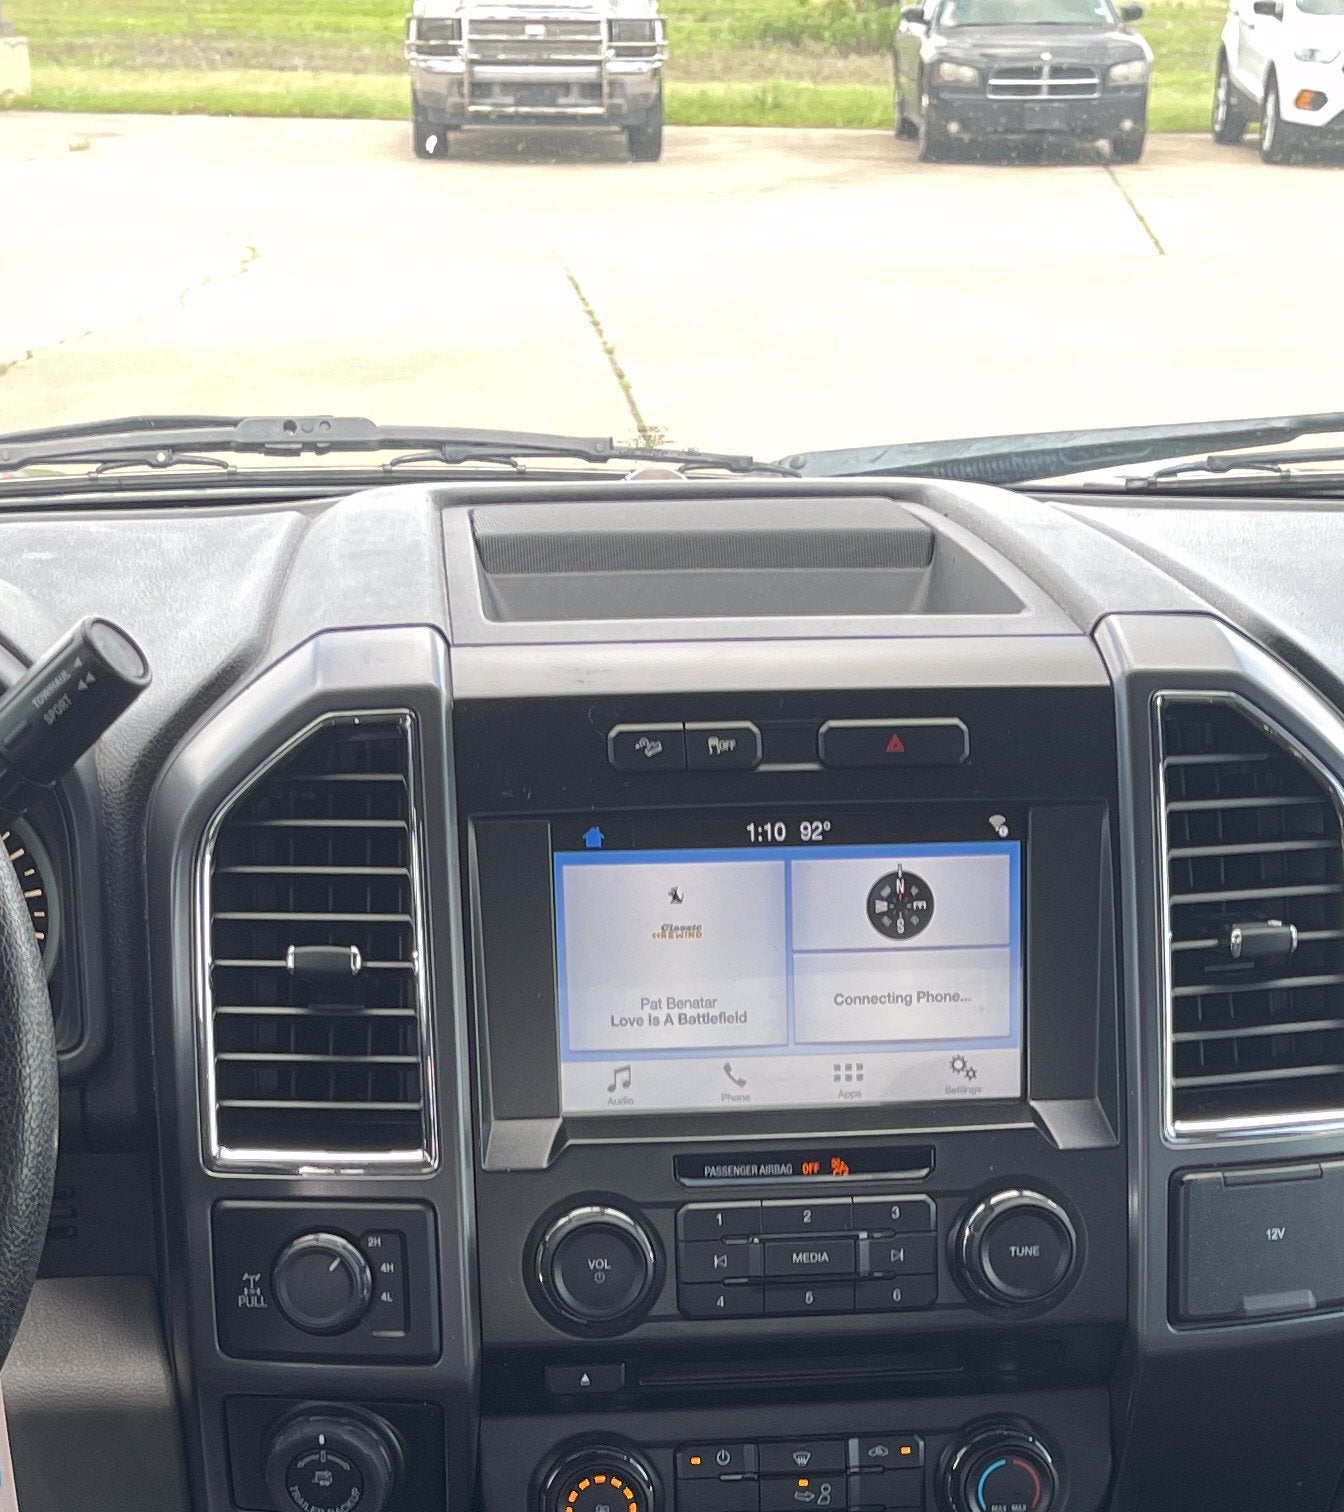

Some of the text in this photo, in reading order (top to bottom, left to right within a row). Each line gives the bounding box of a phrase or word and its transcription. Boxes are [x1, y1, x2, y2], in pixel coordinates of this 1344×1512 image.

[44, 693, 72, 726] SPORT
[746, 821, 787, 842] 1:10
[896, 878, 905, 894] N
[896, 917, 905, 934] S
[640, 996, 718, 1010] Pat Benatar
[833, 990, 972, 1006] Connecting Phone...
[610, 1011, 747, 1027] Love Is A Battlefield
[838, 1089, 862, 1100] Apps
[945, 1083, 982, 1096] Settings
[607, 1096, 635, 1106] Audio
[721, 1092, 751, 1103] Phone
[704, 1160, 821, 1177] PASSENGER AIRBAG OFF
[803, 1210, 811, 1223] 2
[891, 1206, 900, 1219] 3
[716, 1213, 723, 1226] 1
[1266, 1227, 1286, 1241] 12V
[367, 1236, 382, 1247] 2H
[792, 1251, 829, 1264] MEDIA
[1009, 1245, 1040, 1258] TUNE
[380, 1262, 394, 1273] 4H
[587, 1259, 611, 1270] VOL
[238, 1294, 268, 1308] PULL
[380, 1291, 393, 1302] 4L
[805, 1290, 813, 1304] 5
[893, 1288, 901, 1301] 6
[716, 1295, 724, 1308] 4
